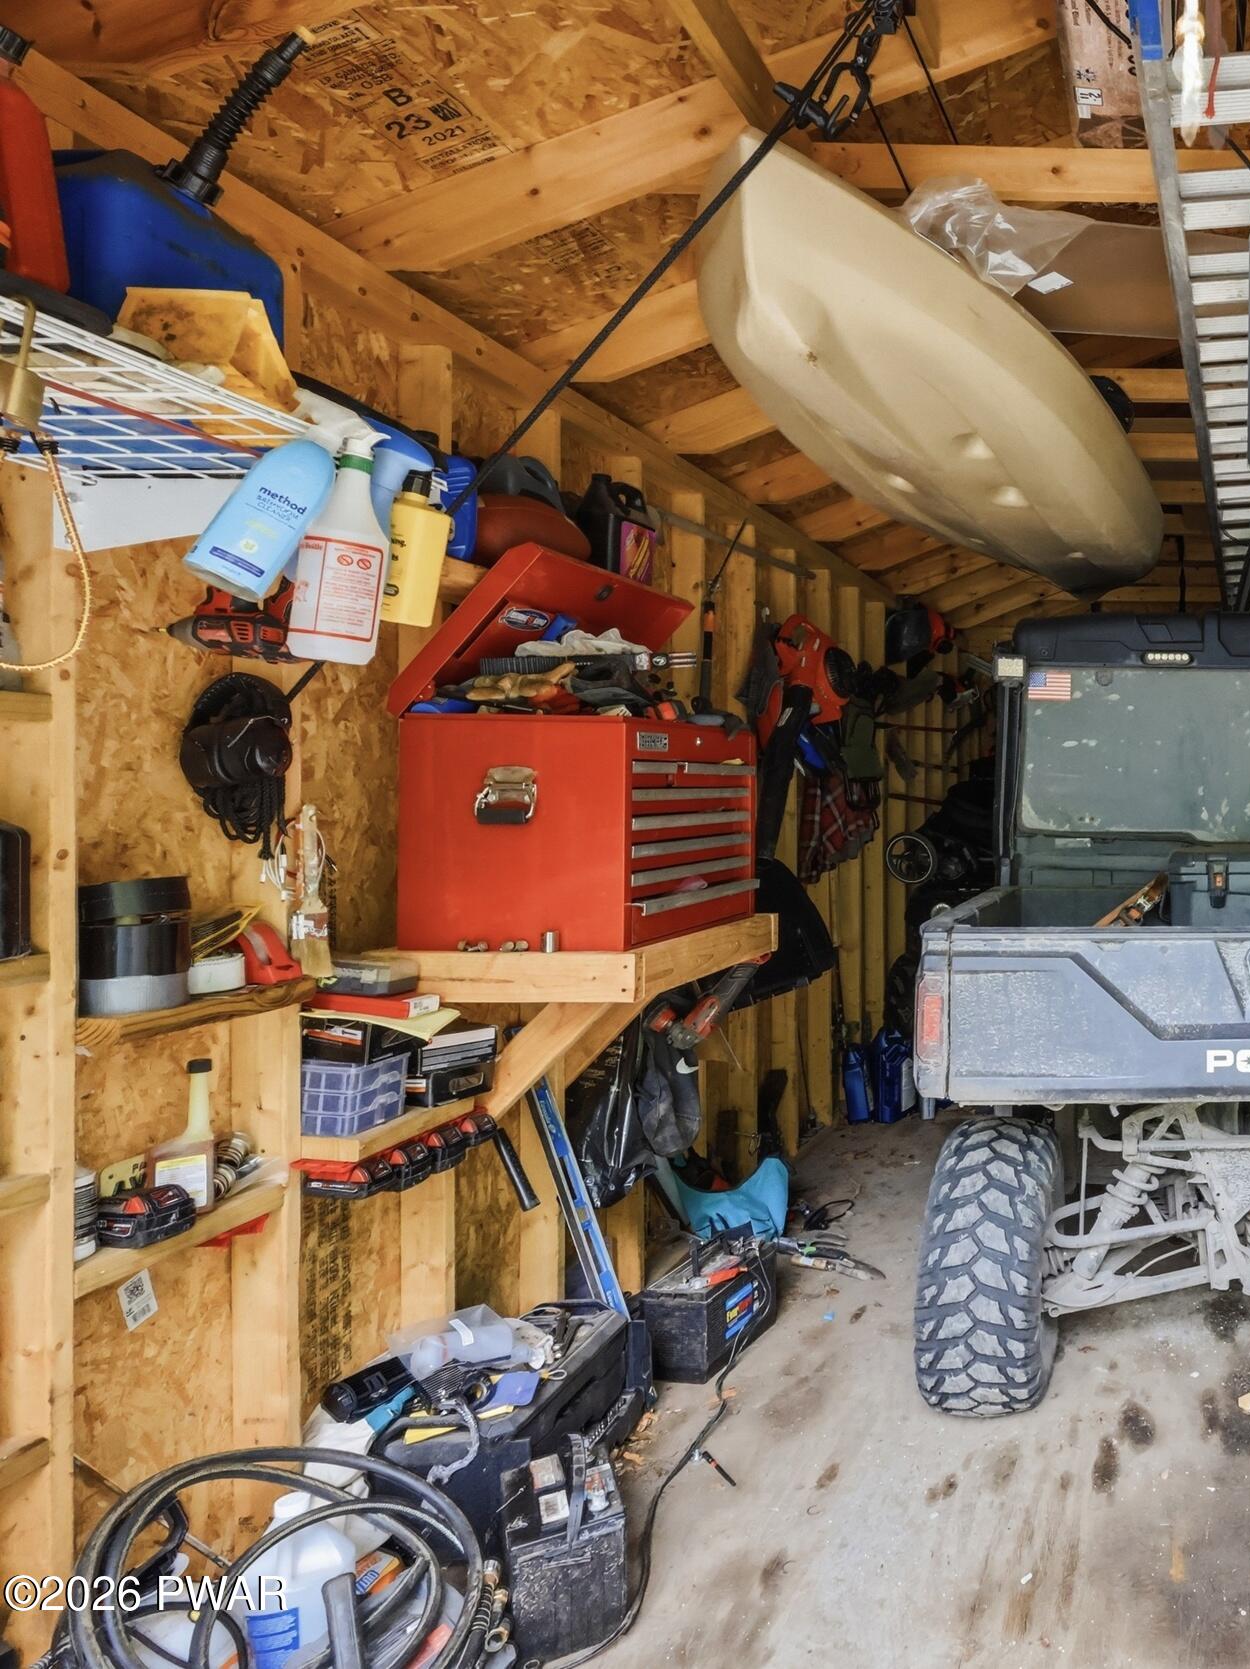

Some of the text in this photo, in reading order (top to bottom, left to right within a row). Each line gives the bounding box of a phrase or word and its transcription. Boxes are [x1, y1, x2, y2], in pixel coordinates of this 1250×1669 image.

[360, 73, 394, 90] OSB
[382, 87, 413, 107] B
[385, 113, 432, 140] 23
[421, 125, 467, 146] 2021
[259, 486, 308, 515] method
